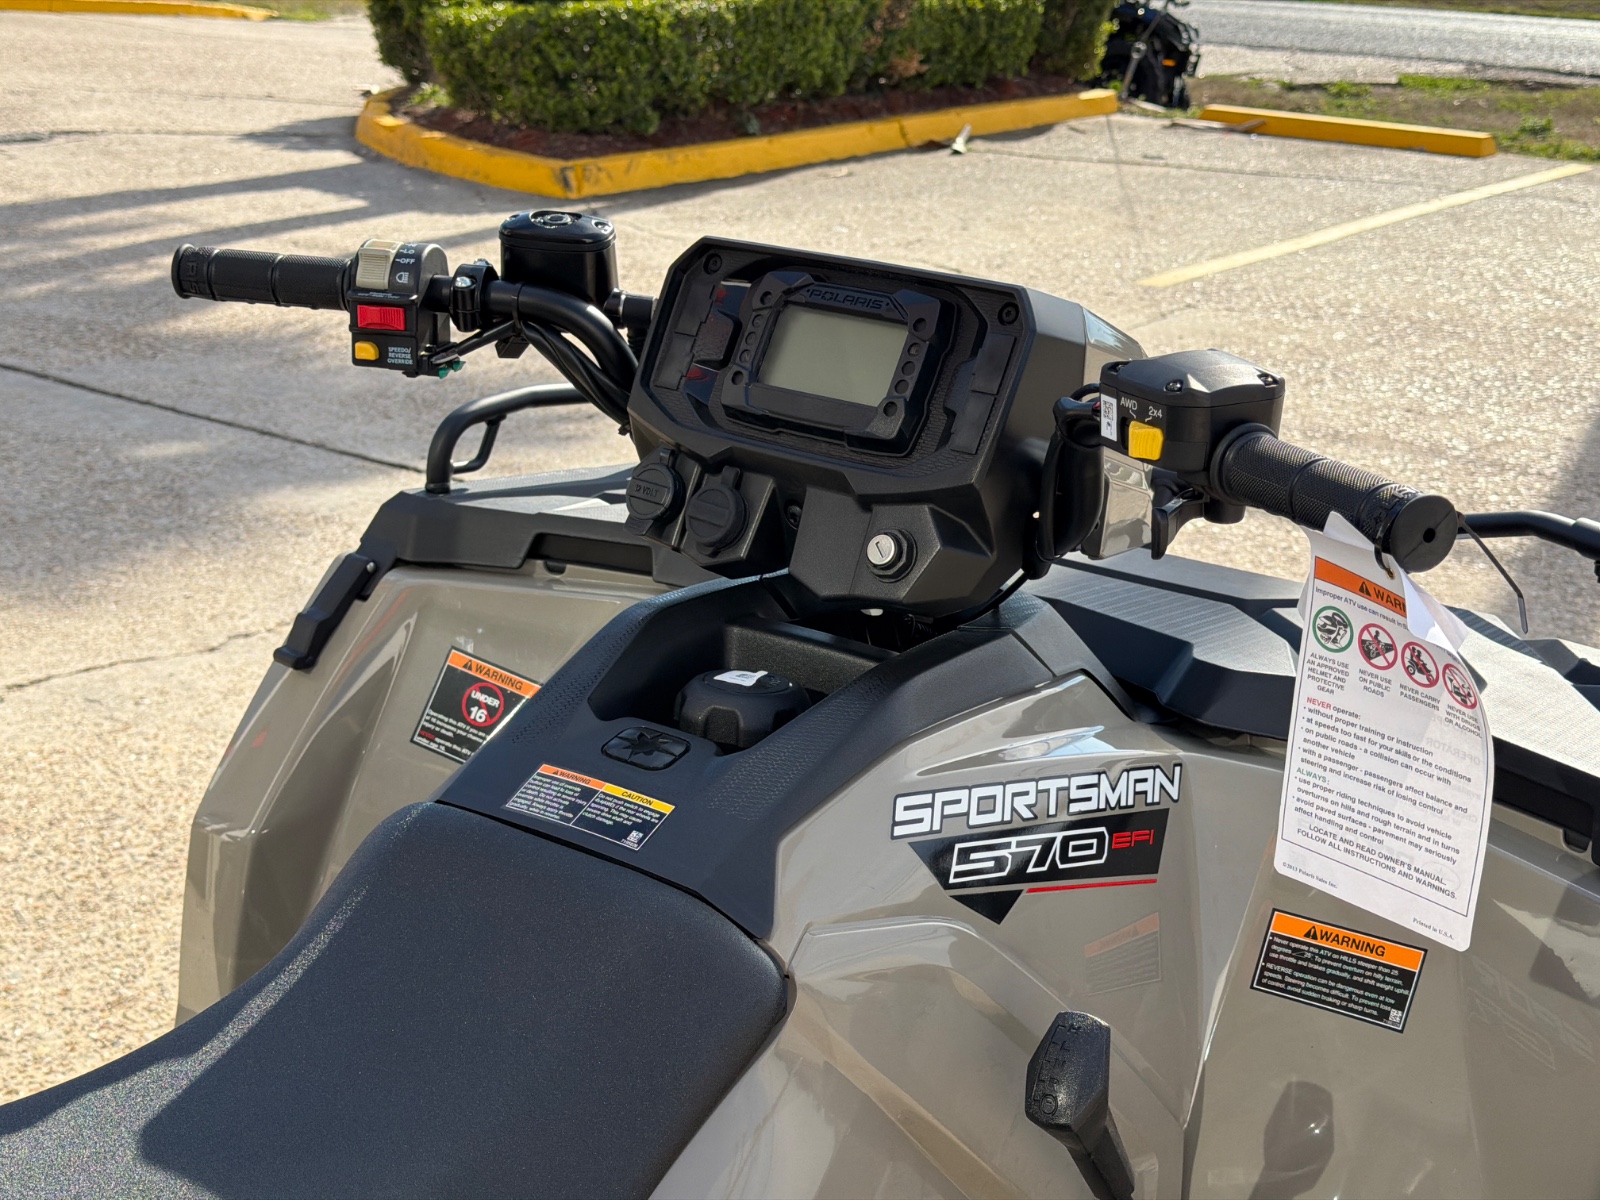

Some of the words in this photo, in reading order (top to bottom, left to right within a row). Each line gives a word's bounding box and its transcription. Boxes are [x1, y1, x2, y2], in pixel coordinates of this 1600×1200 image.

[810, 288, 884, 310] POLARIS
[1120, 396, 1138, 410] AWD
[1148, 406, 1162, 418] 2x4
[642, 486, 659, 498] VOLT
[1316, 586, 1343, 600] Improper
[1344, 597, 1356, 606] ATV
[1380, 613, 1396, 624] result
[1310, 652, 1336, 665] ALWAYS
[1335, 661, 1349, 669] USE
[1316, 662, 1349, 677] APPROVED
[475, 663, 523, 690] WARNING
[1307, 674, 1344, 691] PROTECTIVE
[1308, 667, 1332, 678] HELMET
[1333, 675, 1346, 683] AND
[1359, 669, 1379, 680] NEVER
[1380, 676, 1392, 685] USE
[1317, 685, 1334, 695] GEAR
[1363, 685, 1384, 698] ROADS
[1369, 680, 1390, 692] PUBLIC
[1400, 683, 1419, 695] NEVER
[1420, 692, 1440, 704] CARRY
[471, 690, 500, 708] UNDER
[1307, 697, 1332, 710] NEVER
[1332, 706, 1360, 720] operate:
[1400, 691, 1439, 711] PASSENGERS
[470, 706, 487, 722] 16
[1446, 710, 1460, 720] WITH
[1447, 704, 1466, 717] NEVER
[1467, 714, 1478, 724] USE
[1308, 708, 1333, 720] without
[1334, 717, 1358, 728] proper
[1359, 724, 1386, 740] training
[1396, 737, 1433, 757] instruction
[1445, 717, 1453, 725] OR
[1454, 722, 1483, 739] ALCOHOL
[1303, 738, 1329, 750] another
[1331, 747, 1355, 760] vehicle
[1315, 721, 1339, 733] speeds
[1341, 728, 1352, 737] too
[1354, 733, 1366, 742] fast
[1368, 738, 1378, 746] for
[1379, 743, 1394, 752] your
[1395, 749, 1411, 759] skills
[1422, 758, 1433, 768] the
[1434, 764, 1471, 783] conditions
[1315, 732, 1336, 743] public
[1338, 739, 1358, 750] roads
[1370, 751, 1399, 765] collision
[1400, 762, 1413, 771] can
[1415, 768, 1435, 779] occur
[1436, 776, 1451, 786] with
[559, 771, 591, 785] WARNING
[1296, 767, 1330, 785] ALWAYS:
[1301, 758, 1327, 772] steering
[1329, 768, 1342, 776] and
[1343, 771, 1372, 787] increase
[1373, 784, 1386, 793] risk
[1396, 791, 1417, 806] losing
[1418, 802, 1443, 815] control
[1303, 748, 1316, 756] with
[1323, 756, 1359, 771] passenger
[1364, 770, 1403, 788] passengers
[1405, 786, 1424, 797] affect
[1426, 792, 1453, 808] balance
[1454, 805, 1468, 814] and
[621, 791, 653, 806] CAUTION
[891, 763, 1182, 840] SPORTSMAN
[1299, 778, 1311, 786] use
[1312, 782, 1335, 794] proper
[1336, 791, 1356, 804] riding
[1358, 799, 1395, 818] techniques
[1406, 818, 1425, 830] avoid
[1427, 826, 1452, 840] vehicle
[1294, 807, 1313, 818] affect
[1314, 813, 1344, 830] handling
[1345, 826, 1358, 835] and
[1359, 832, 1384, 845] control
[1296, 797, 1314, 808] avoid
[1316, 805, 1336, 816] paved
[1338, 813, 1367, 828] surfaces
[1373, 827, 1406, 844] pavement
[1408, 840, 1423, 851] may
[1425, 847, 1457, 865] seriously
[1297, 787, 1329, 803] overturns
[1341, 802, 1355, 813] hills
[1357, 810, 1370, 818] and
[1371, 815, 1392, 827] rough
[1394, 823, 1416, 837] terrain
[1418, 834, 1431, 843] and
[1441, 842, 1460, 854] turns
[949, 827, 1109, 883] 570
[1112, 830, 1154, 849] EFI
[1297, 828, 1327, 844] FOLLOW
[1328, 841, 1342, 852] ALL
[1343, 847, 1396, 873] INSTRUCTIONS
[1398, 870, 1414, 880] AND
[1416, 876, 1456, 899] WARNINGS.
[1309, 824, 1337, 840] LOCATE
[1339, 836, 1354, 847] AND
[1356, 843, 1376, 856] READ
[1378, 852, 1412, 871] OWNER'S
[1414, 866, 1446, 886] MANUAL.
[1299, 868, 1315, 879] Polaris
[1316, 876, 1327, 884] Sales
[1320, 930, 1386, 957] WARNING
[1439, 929, 1454, 940] U.S.A.
[1273, 937, 1289, 945] Never
[1289, 942, 1309, 950] operate
[1340, 955, 1357, 964] HILLS
[1357, 961, 1378, 969] steeper
[1266, 963, 1293, 974] REVERSE
[1293, 971, 1317, 981] operation
[1336, 983, 1364, 995] dangerous
